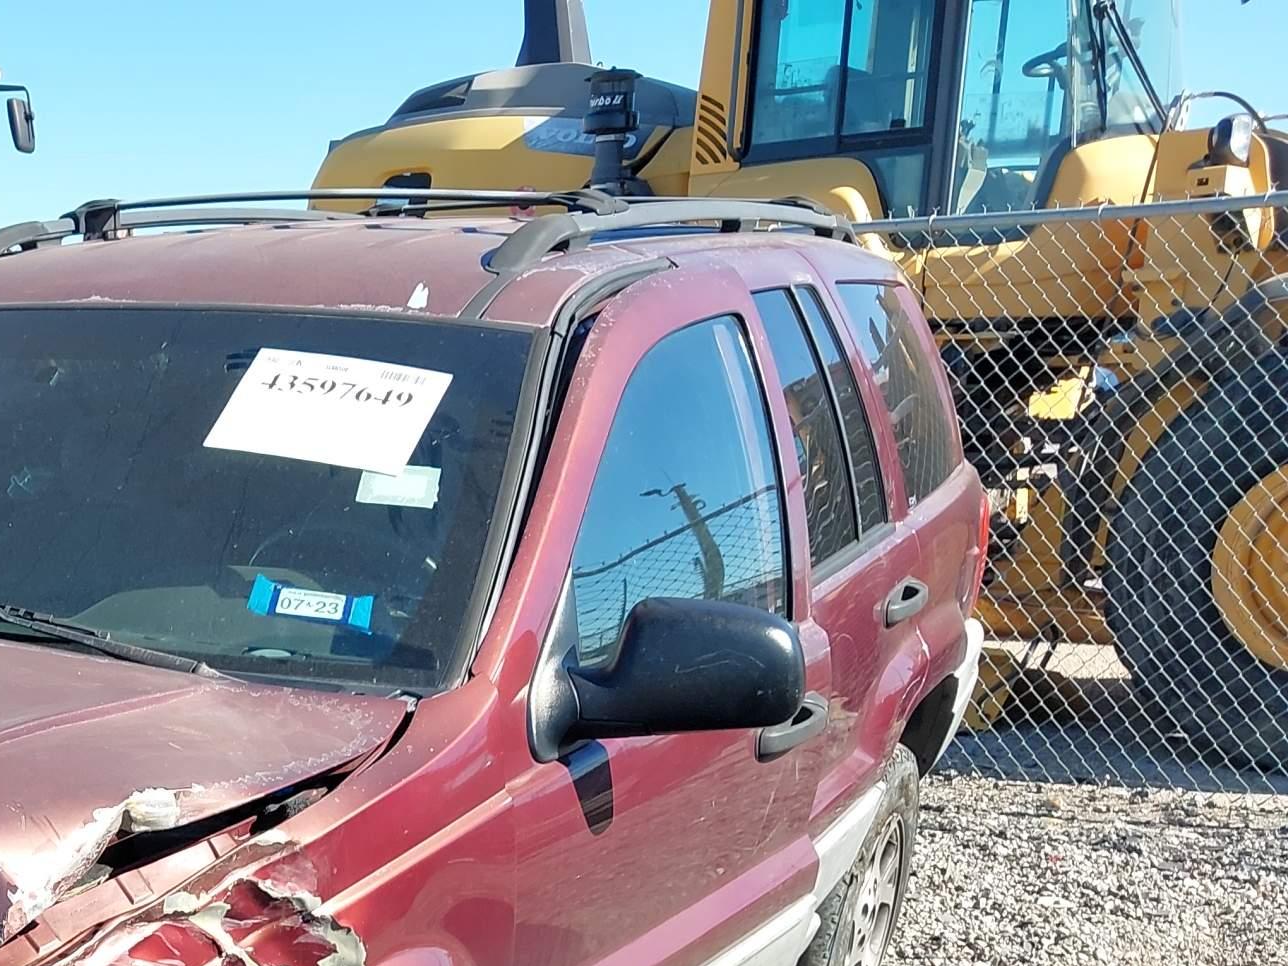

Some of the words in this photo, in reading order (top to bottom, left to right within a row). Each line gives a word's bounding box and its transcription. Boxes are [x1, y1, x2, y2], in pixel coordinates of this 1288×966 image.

[261, 373, 414, 407] 43597649
[280, 596, 306, 611] 07
[314, 600, 340, 615] 23
